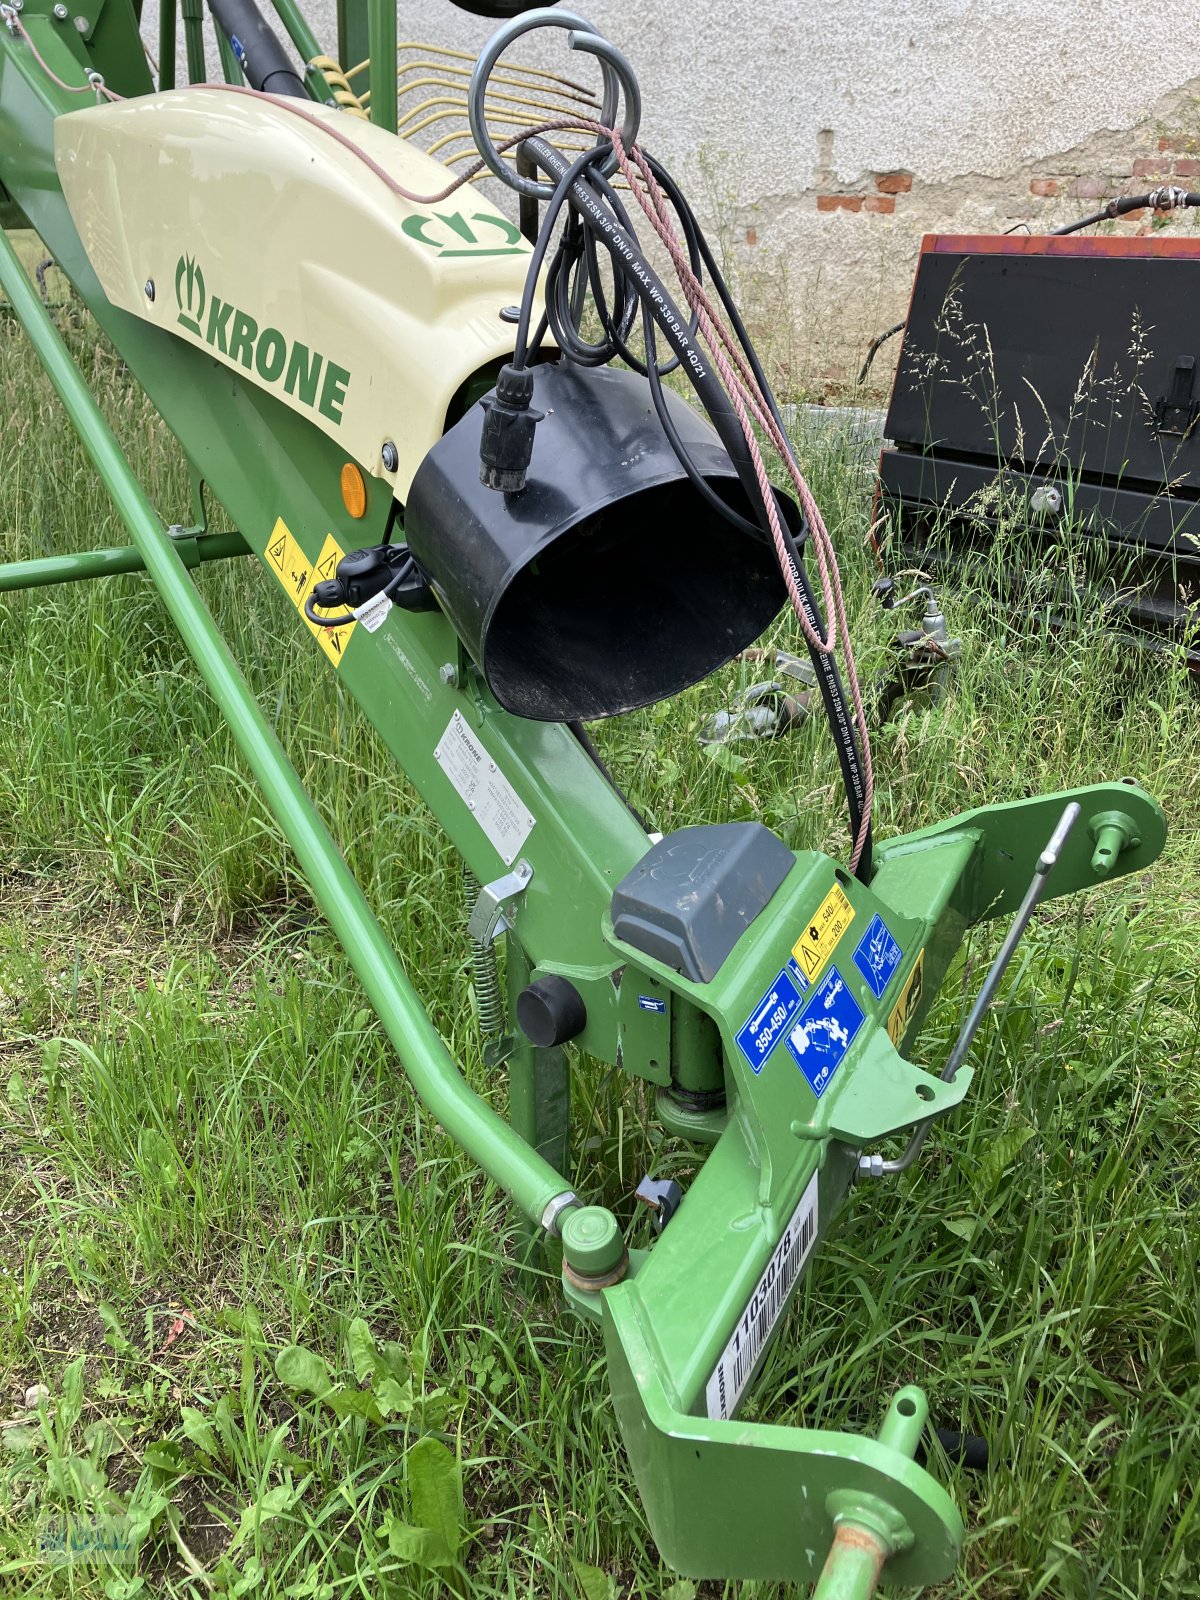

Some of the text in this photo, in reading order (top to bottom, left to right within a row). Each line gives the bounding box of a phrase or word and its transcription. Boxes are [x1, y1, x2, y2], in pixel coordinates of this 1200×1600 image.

[572, 181, 590, 202] N853
[586, 201, 603, 219] 2SN
[612, 234, 634, 260] DN10
[631, 261, 652, 288] MAX.
[649, 286, 664, 304] WP
[659, 304, 675, 324] 330
[670, 322, 689, 348] BAR
[686, 349, 707, 379] 4Q/21
[206, 295, 351, 426] KRONE
[459, 732, 482, 763] KRONE
[854, 784, 863, 799] BAR
[831, 920, 843, 937] 200
[732, 1230, 792, 1350] 1103078
[717, 1362, 726, 1411] KRONE
